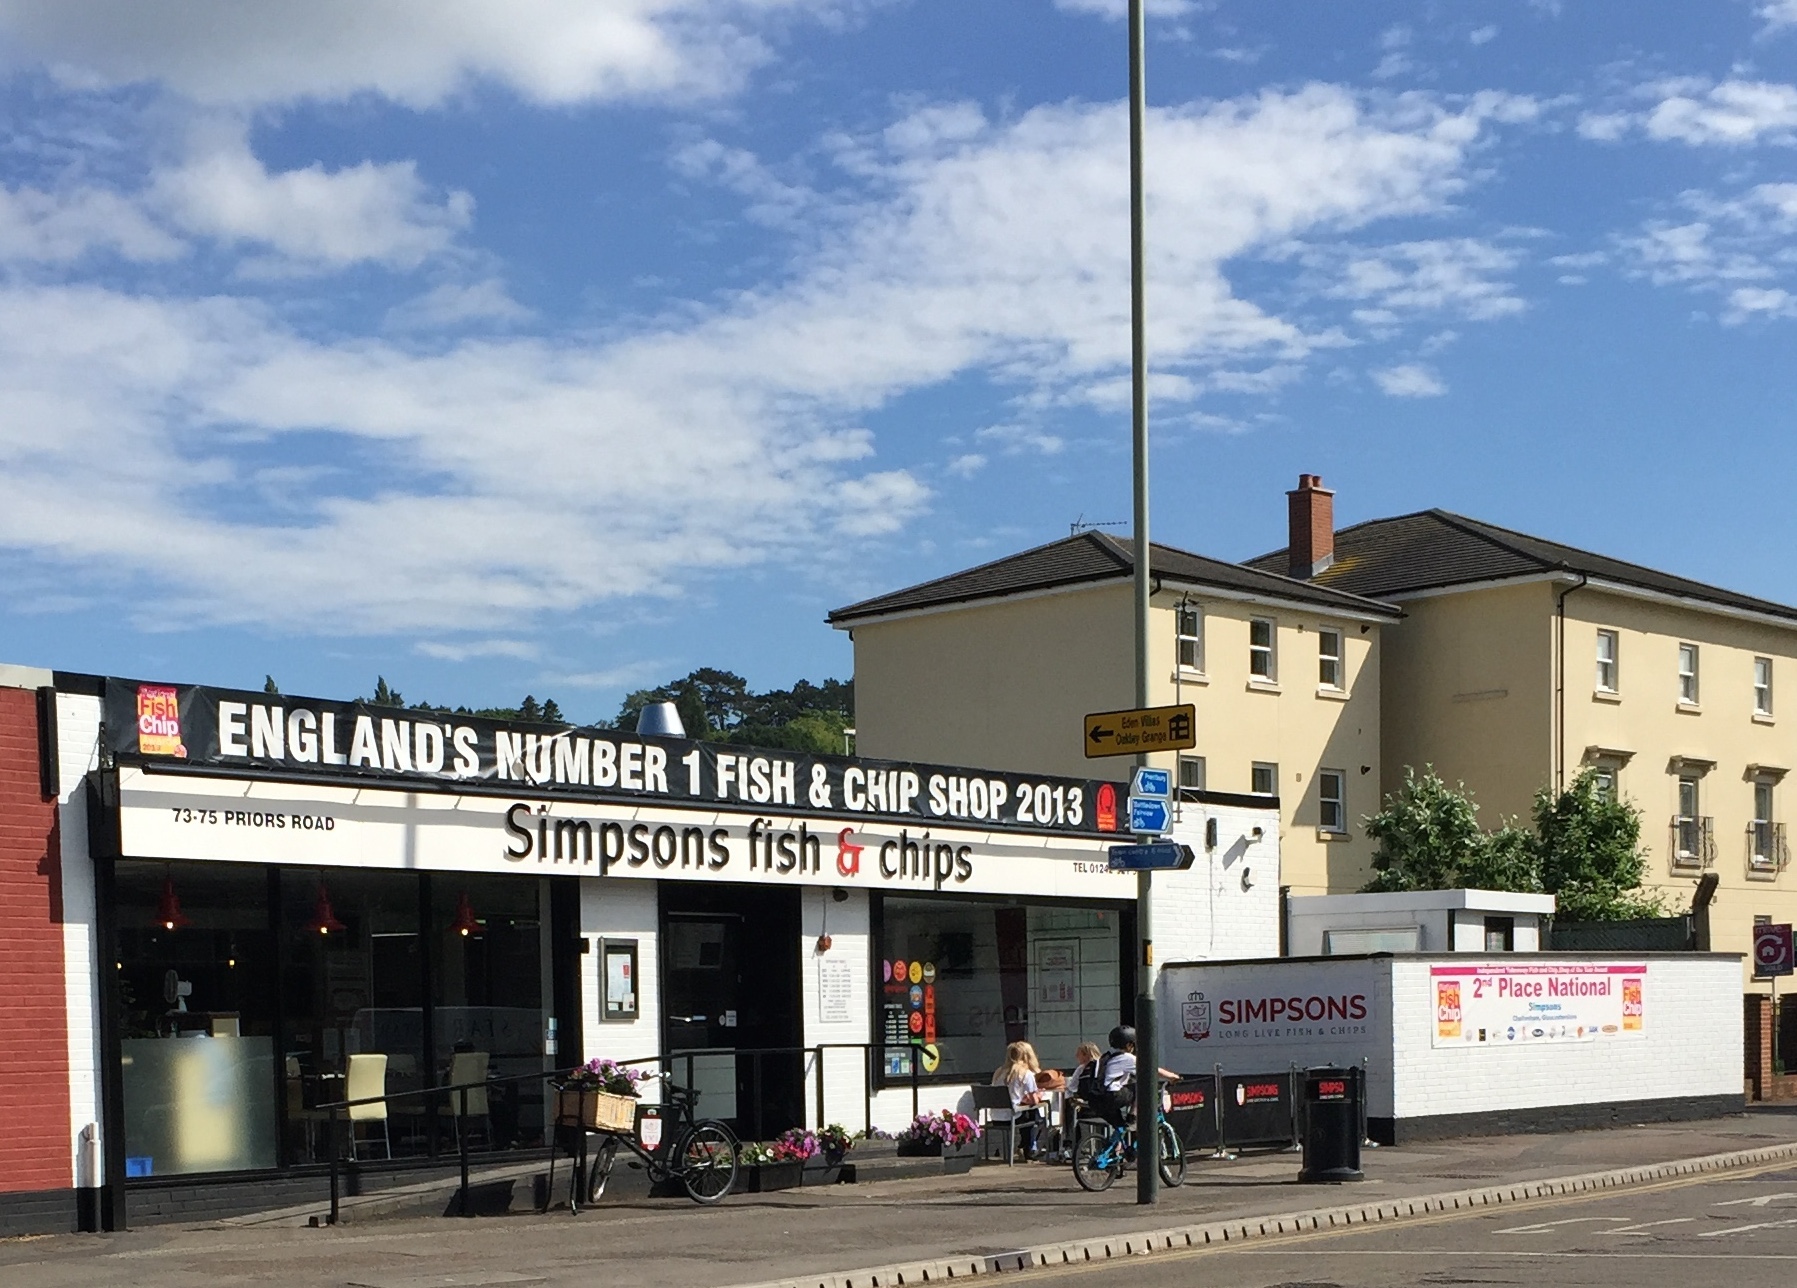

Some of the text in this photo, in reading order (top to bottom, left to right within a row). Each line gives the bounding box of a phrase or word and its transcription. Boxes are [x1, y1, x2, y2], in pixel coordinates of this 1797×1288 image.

[140, 696, 177, 718] Fish
[139, 714, 179, 737] Chip
[218, 700, 1083, 826] ENGLAND'S NUMBER 1 FISH & CHIP SHOP 2013
[172, 807, 335, 831] 73-75 PRIORS ROAD
[504, 803, 973, 890] Simpsons fish & chips
[1073, 862, 1087, 873] TEL
[1472, 976, 1611, 998] 2nd Place National
[1439, 989, 1460, 1008] Fish
[1528, 1002, 1562, 1012] Simpsons
[1218, 995, 1368, 1024] SIMPSONS
[1438, 1005, 1461, 1022] Chip
[1623, 1000, 1642, 1017] Chip
[1219, 1025, 1367, 1039] LONG LIVE FISH & CHIPS
[1172, 1091, 1205, 1105] SIMPSONS
[1246, 1083, 1279, 1097] SIMPSONS
